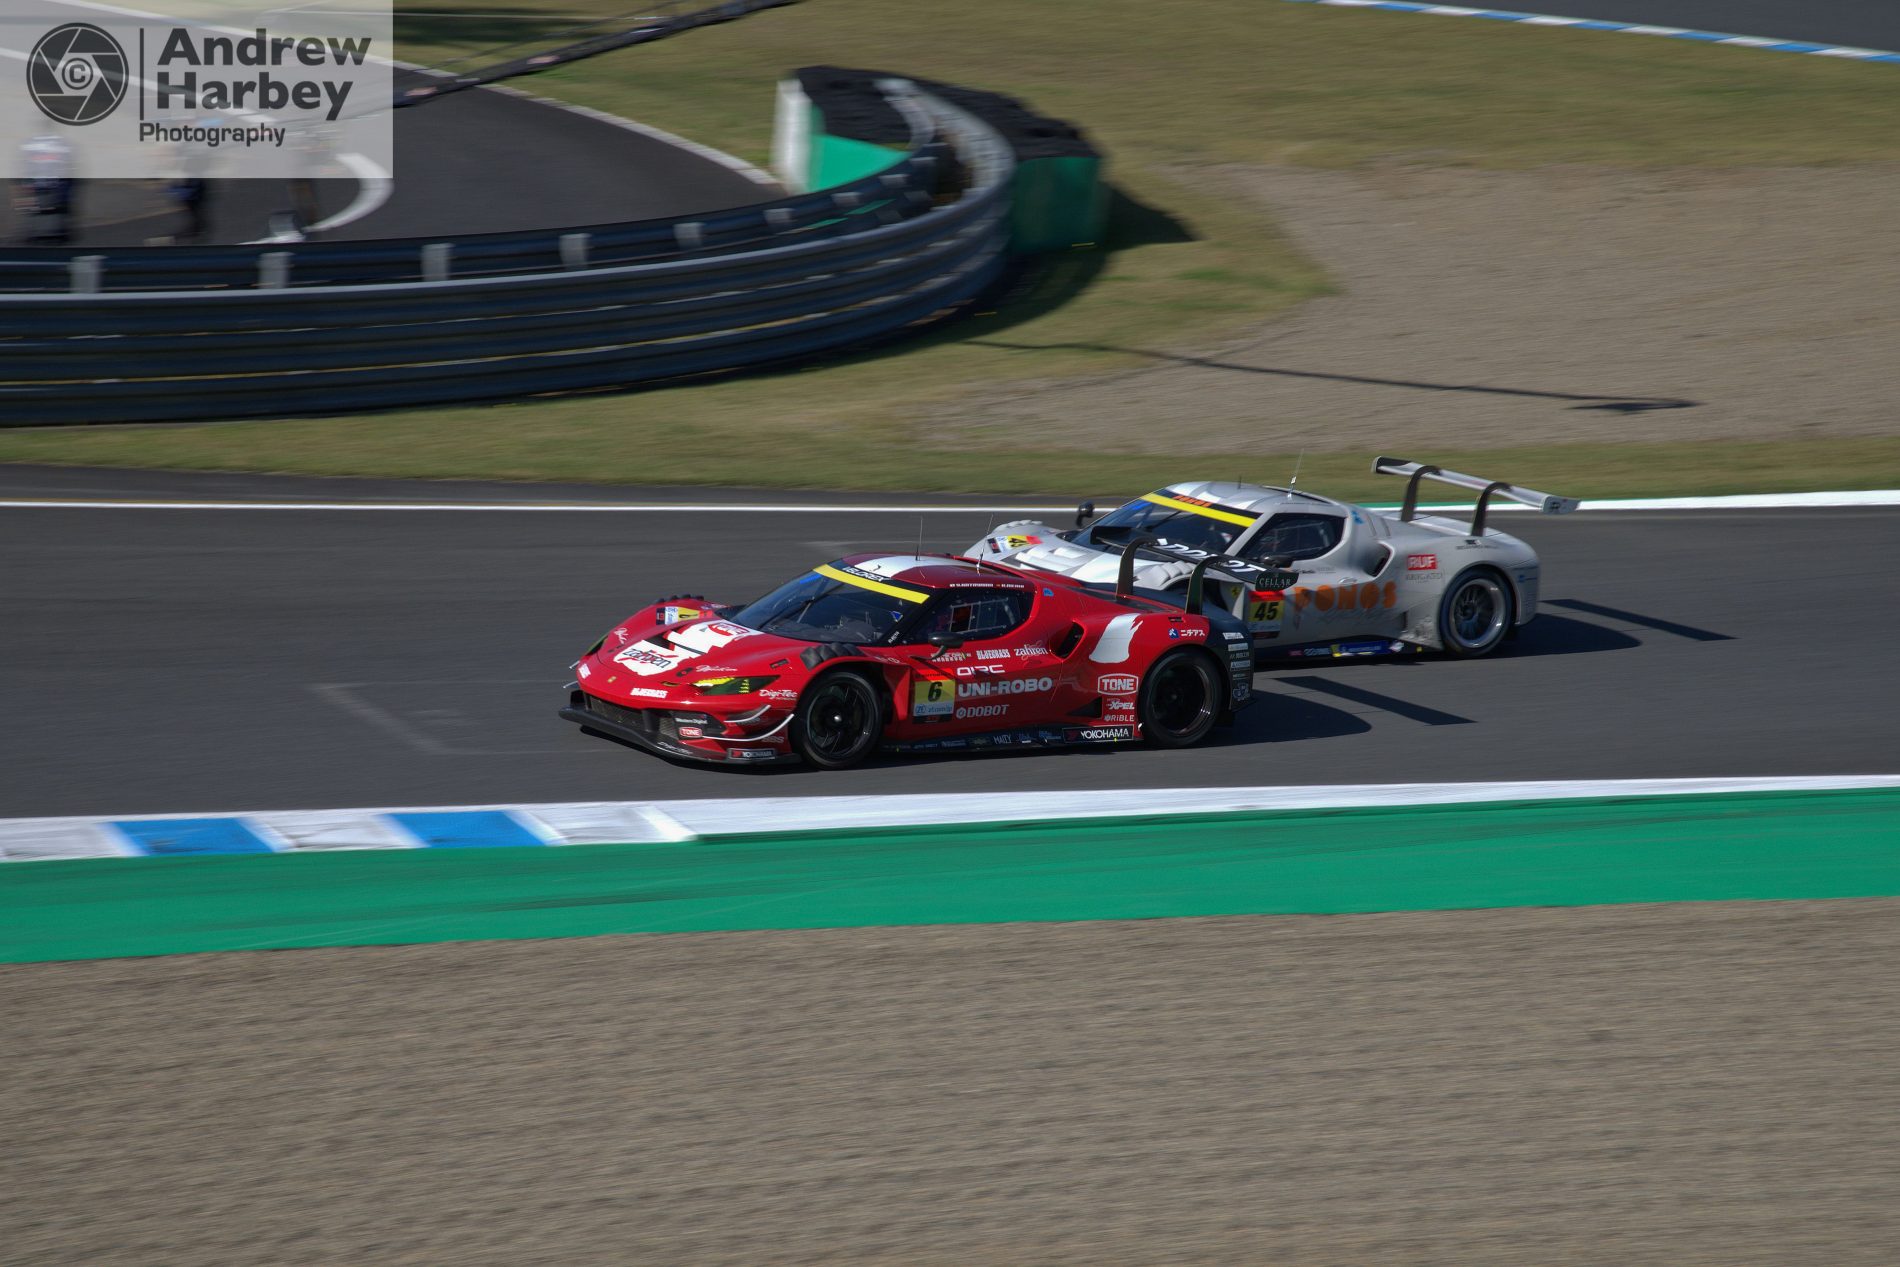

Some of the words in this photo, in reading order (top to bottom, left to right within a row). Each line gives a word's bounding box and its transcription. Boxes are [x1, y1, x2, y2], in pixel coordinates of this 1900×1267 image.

[1259, 577, 1291, 586] CELLAR
[1293, 580, 1397, 612] PONOS
[1254, 602, 1280, 621] 45
[1180, 629, 1206, 637] ニチアス
[976, 649, 1011, 660] BLUEGRASS
[1014, 645, 1048, 656] zahren
[958, 677, 1053, 698] UNI-ROBO
[1102, 678, 1135, 690] TONE
[759, 690, 798, 700] Digi-Tec
[927, 681, 943, 702] 6
[1109, 700, 1135, 710] XPEL
[967, 704, 1010, 718] DOBOT
[682, 728, 700, 737] TONE
[1081, 728, 1130, 740] YOKOHAMA
